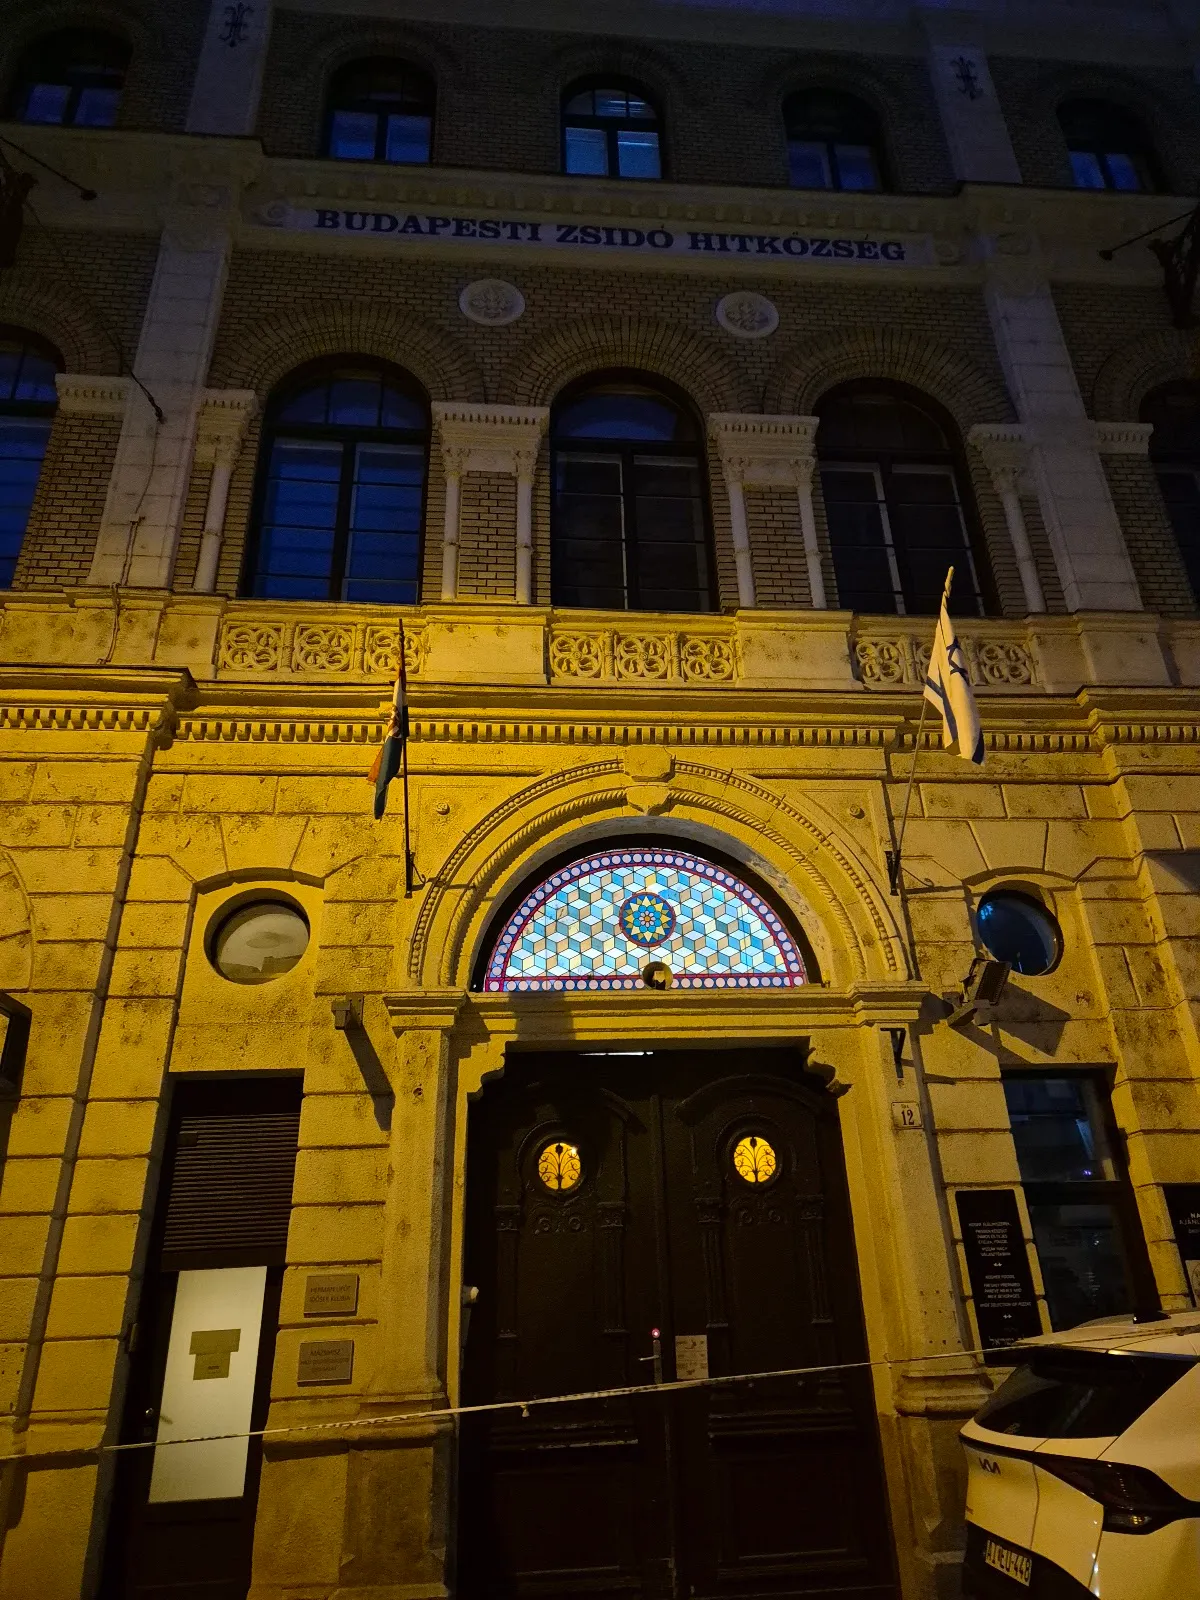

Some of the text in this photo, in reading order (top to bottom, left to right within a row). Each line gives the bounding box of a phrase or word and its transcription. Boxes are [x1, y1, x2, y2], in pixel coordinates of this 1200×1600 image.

[316, 209, 906, 261] BUDAPESTI ZSIDÓ HITKÖZSÉG
[901, 1109, 914, 1125] 12
